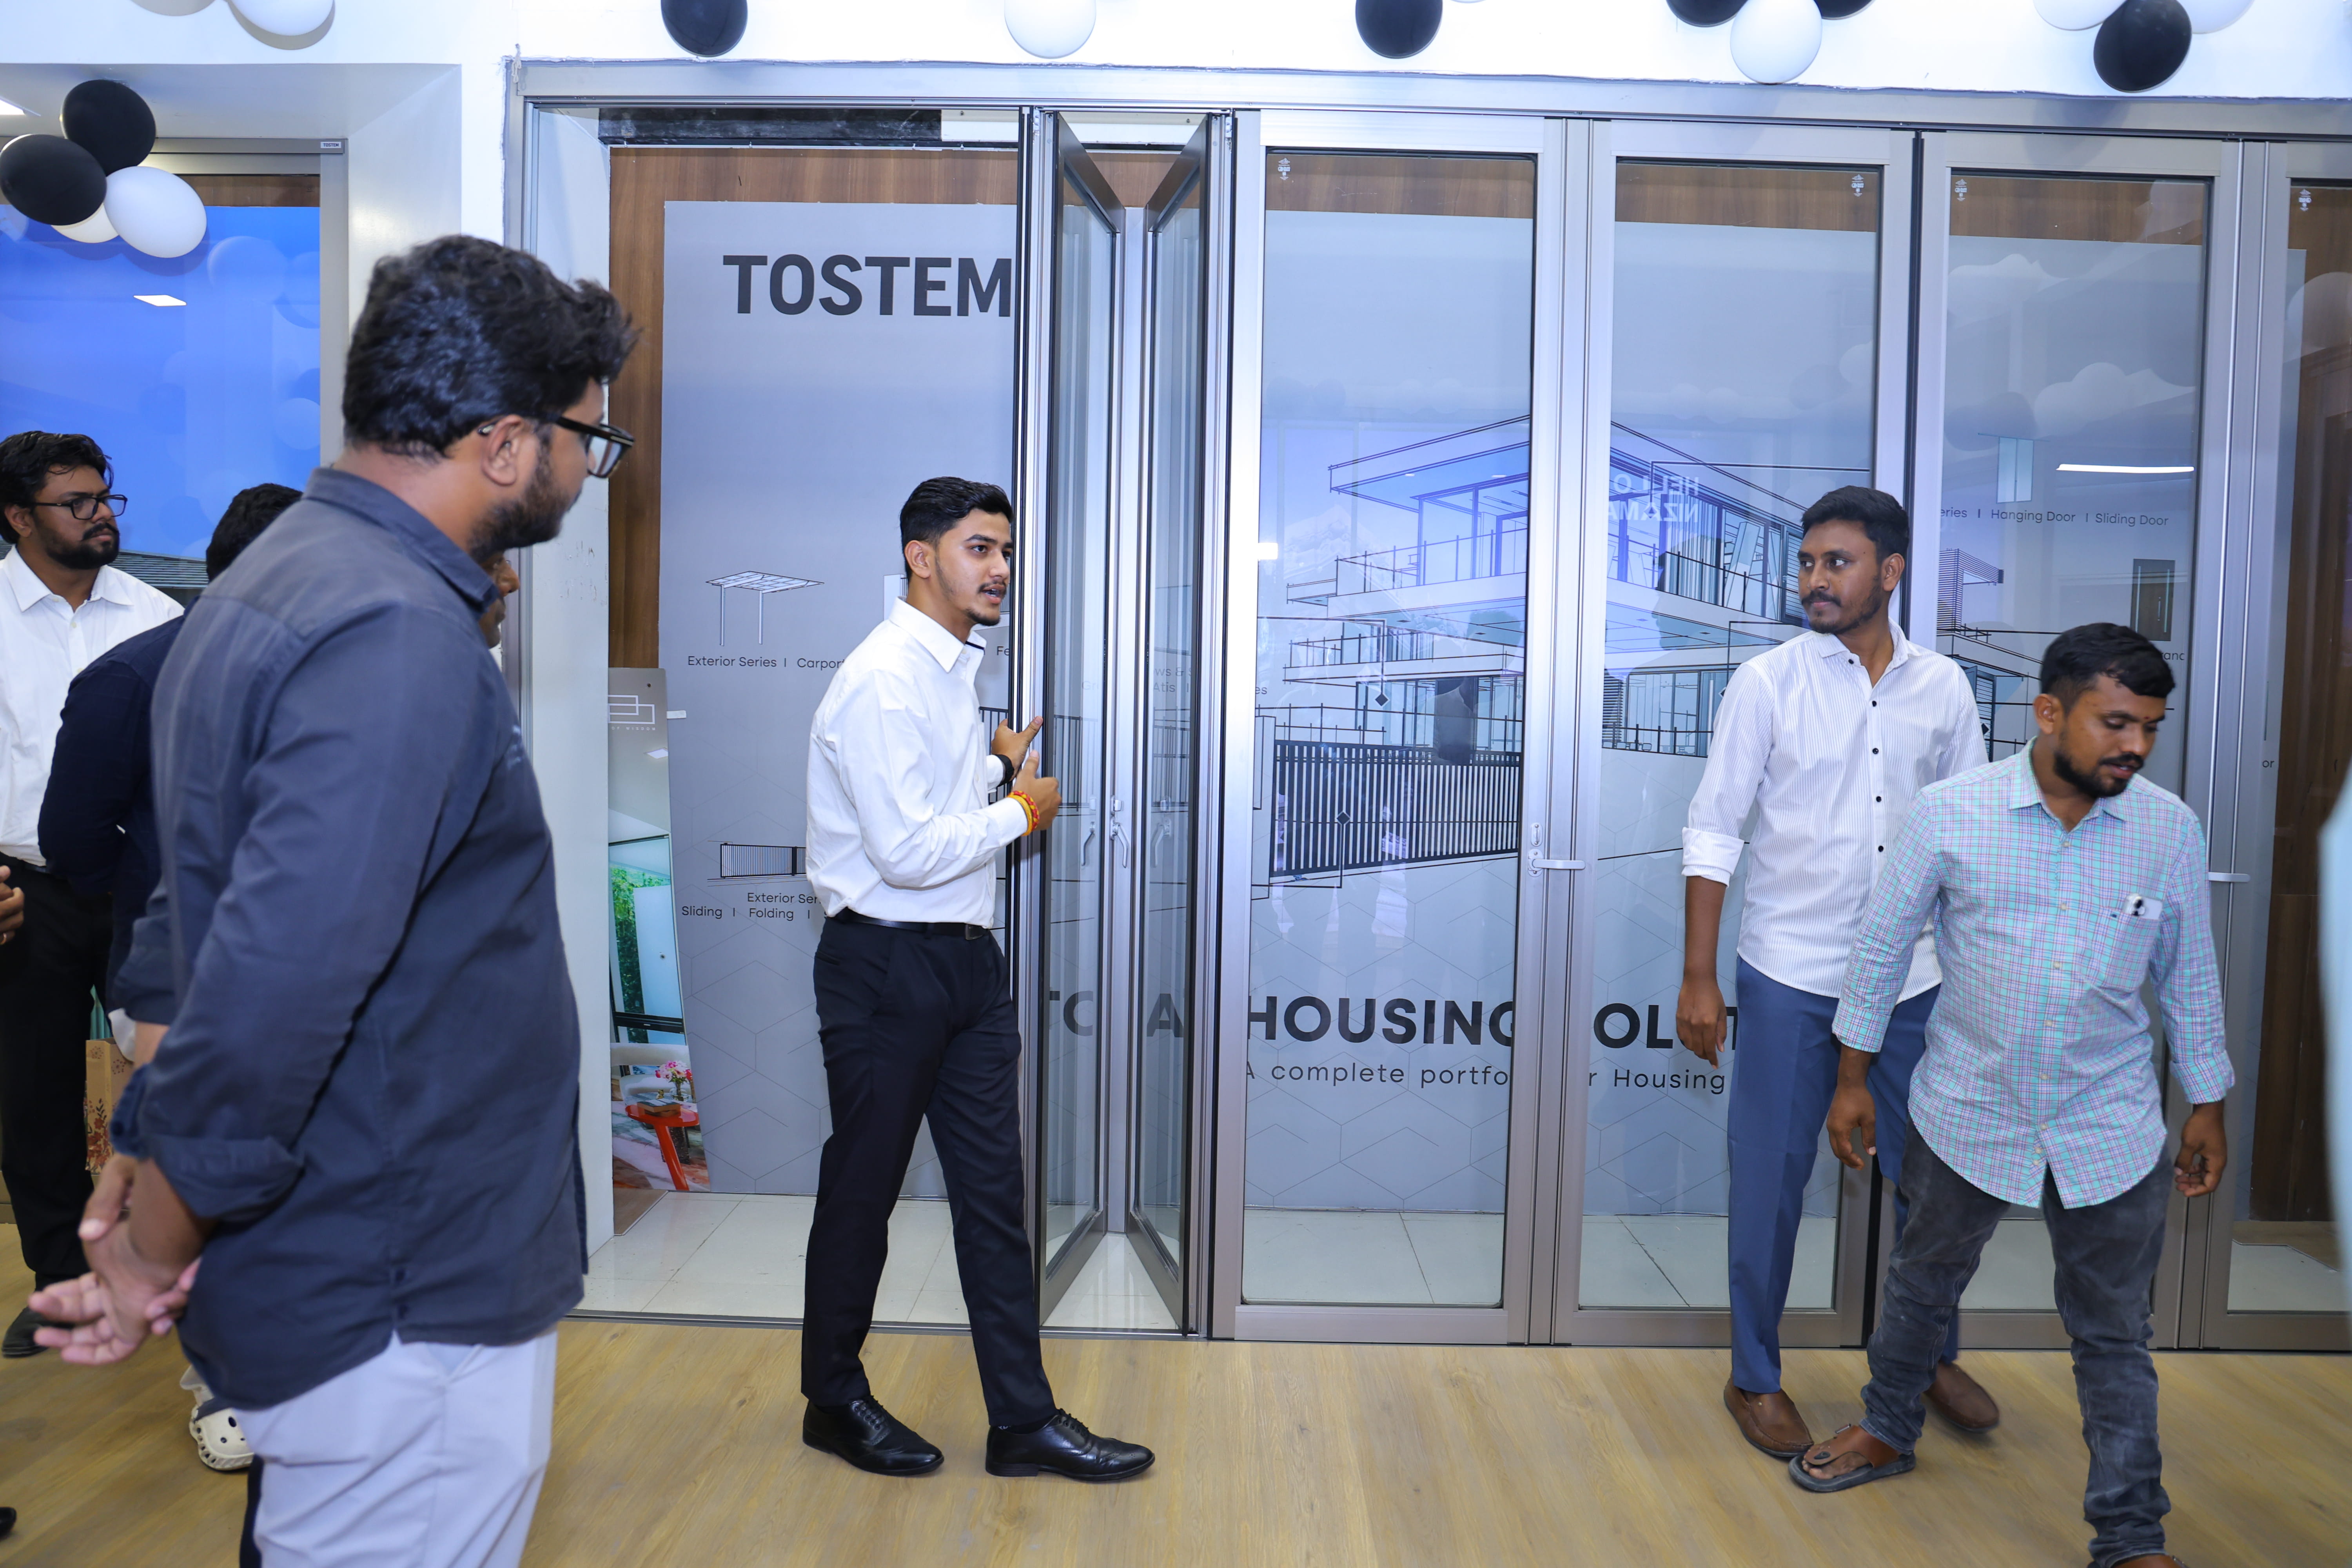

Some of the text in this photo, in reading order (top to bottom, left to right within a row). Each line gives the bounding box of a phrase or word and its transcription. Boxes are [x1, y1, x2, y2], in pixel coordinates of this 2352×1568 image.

[723, 254, 1012, 317] TOSTEM
[1940, 507, 1967, 518] eries
[1991, 509, 2043, 523] Hanging
[2047, 511, 2076, 522] Door
[2095, 513, 2136, 527] Sliding
[2140, 515, 2169, 526] Door
[688, 655, 736, 667] Exterior
[739, 656, 777, 667] Series
[748, 892, 821, 904] Exterior Ser
[682, 906, 723, 919] Sliding
[749, 907, 794, 921] Folding
[1271, 1062, 1405, 1087] complete
[1421, 1065, 1508, 1089] portfo
[1614, 1069, 1725, 1095] Housing
